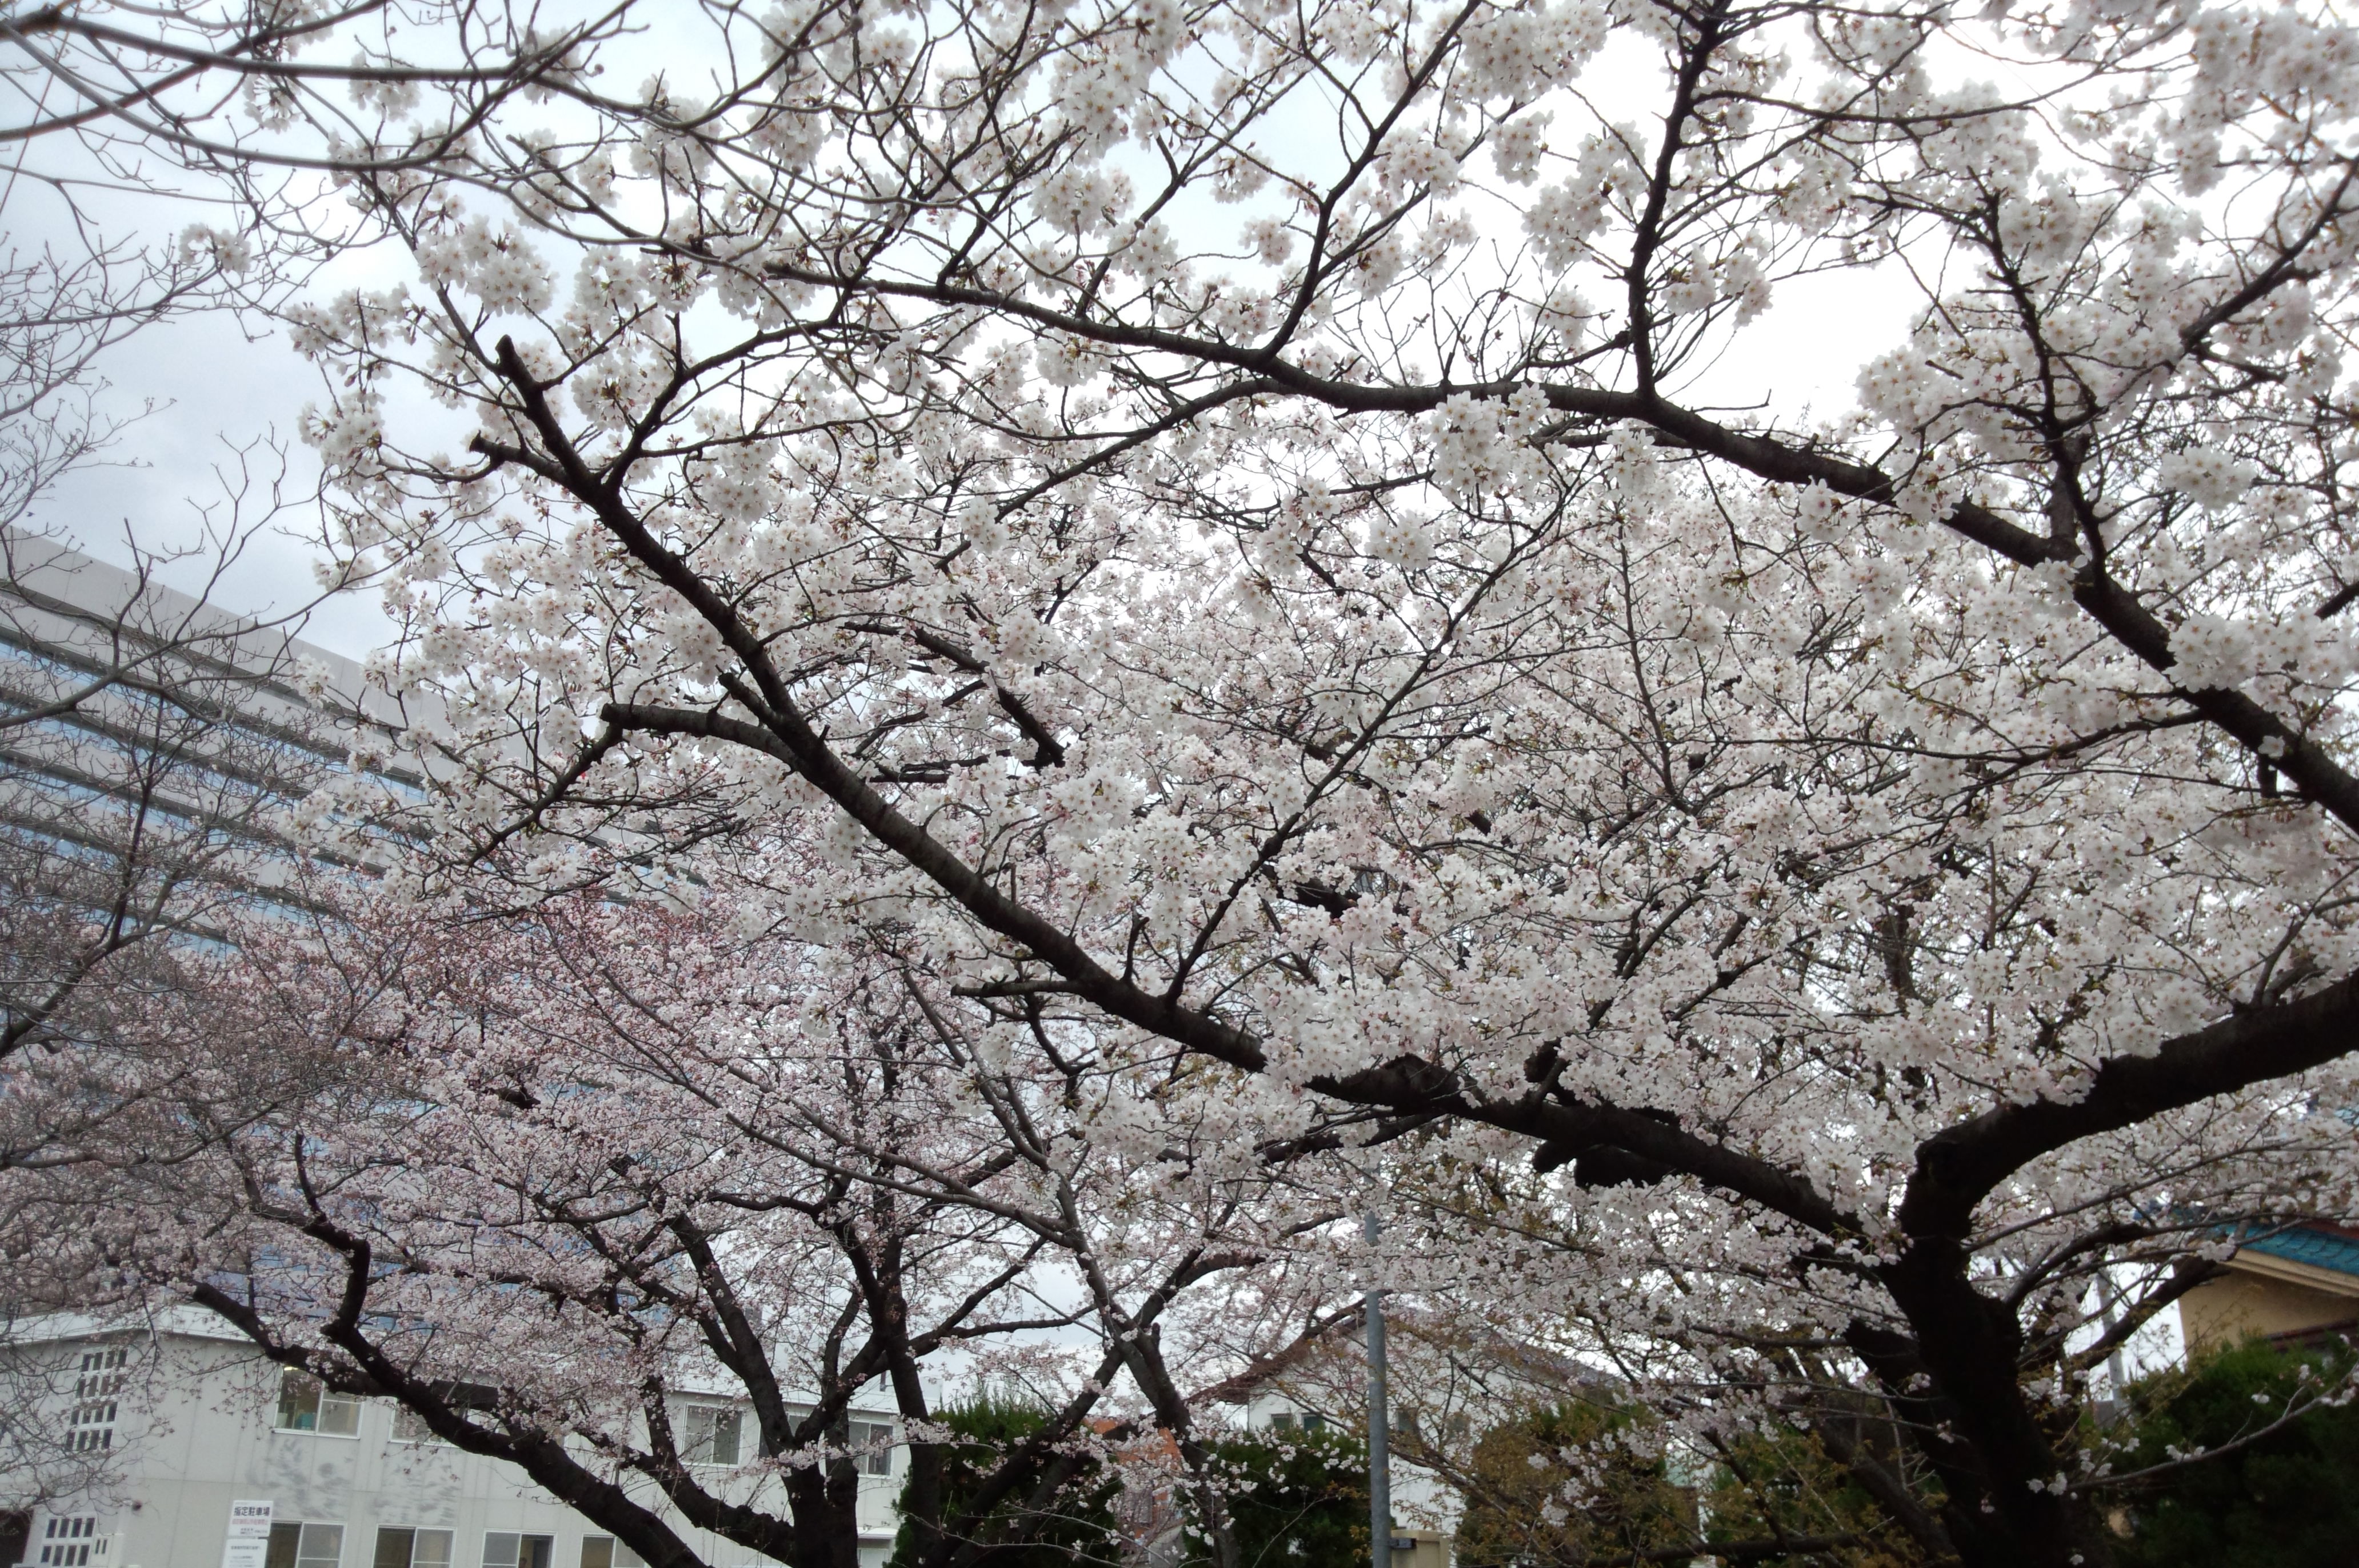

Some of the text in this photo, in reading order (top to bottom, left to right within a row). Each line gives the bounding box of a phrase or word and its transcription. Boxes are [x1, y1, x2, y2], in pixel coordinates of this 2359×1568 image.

[234, 1506, 270, 1517] 指定駐車場
